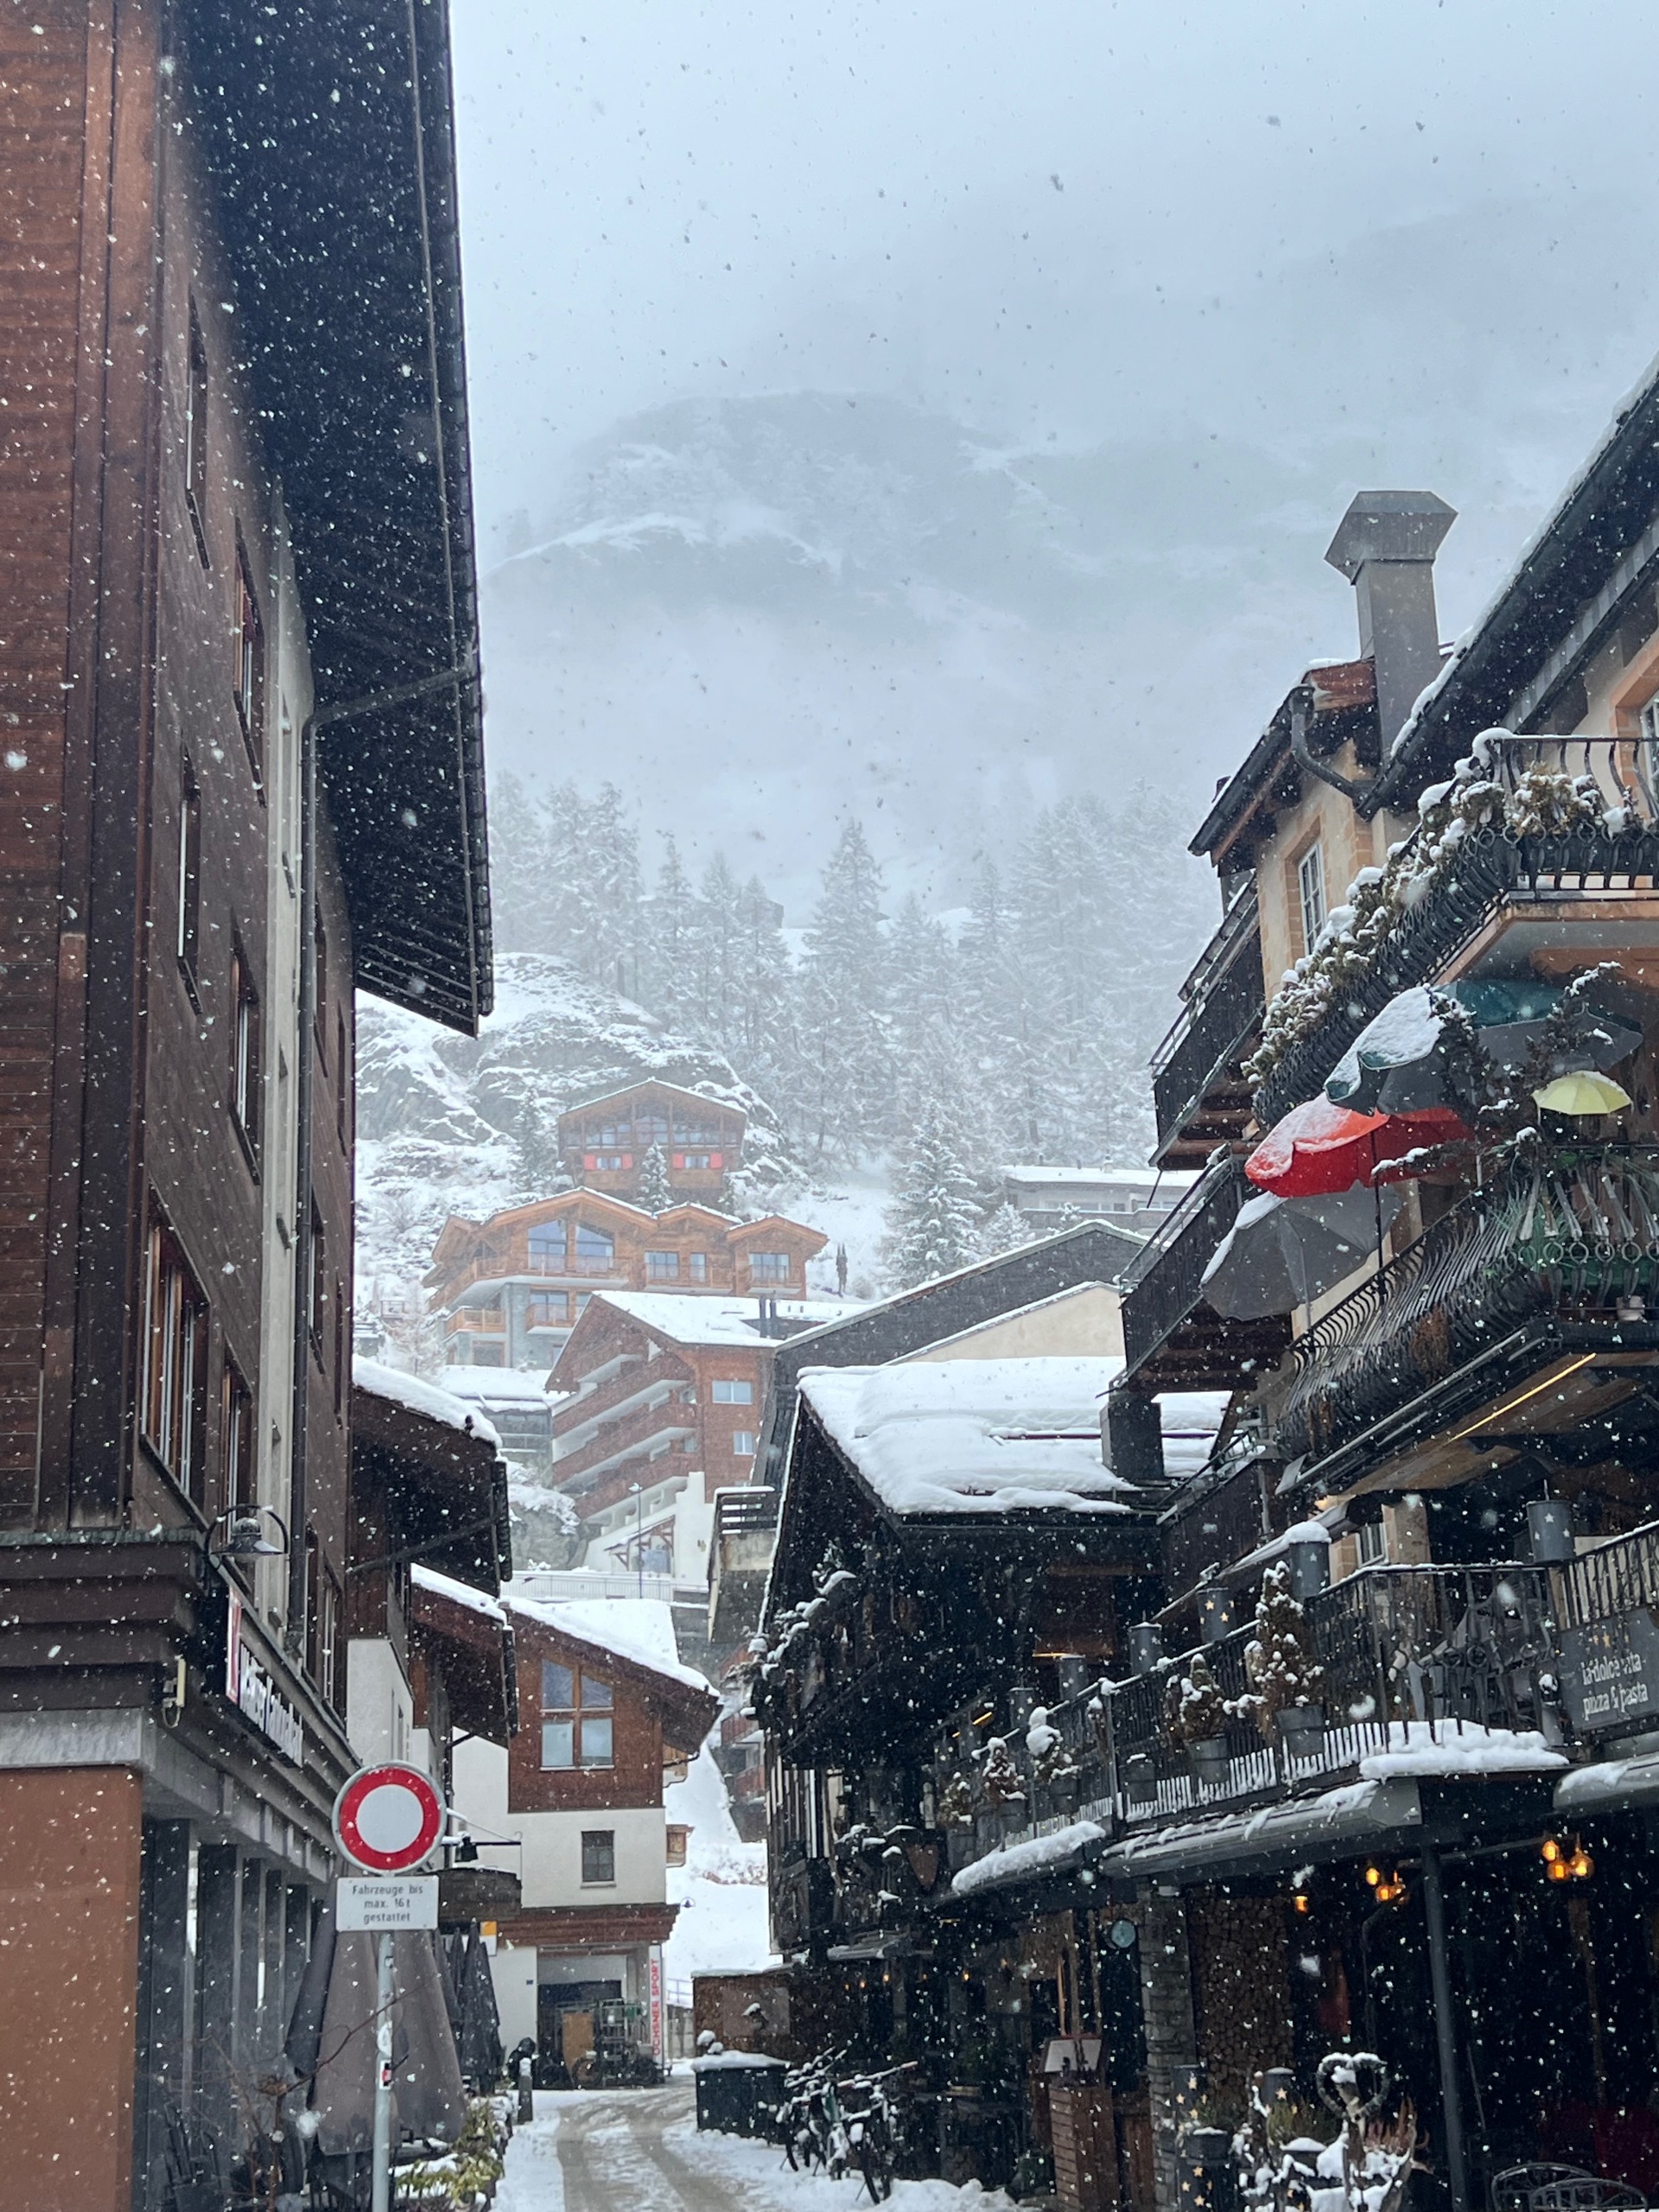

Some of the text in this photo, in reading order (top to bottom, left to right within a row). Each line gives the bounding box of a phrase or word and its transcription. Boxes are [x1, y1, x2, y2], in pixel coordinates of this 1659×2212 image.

[1592, 1656, 1620, 1682] dolce
[1583, 1694, 1610, 1721] pizza
[1619, 1681, 1649, 1713] pasta
[352, 1885, 423, 1897] Fahrzeuge bis
[363, 1913, 410, 1924] gestattet
[651, 1959, 661, 2056] OCHSNER SPORT
